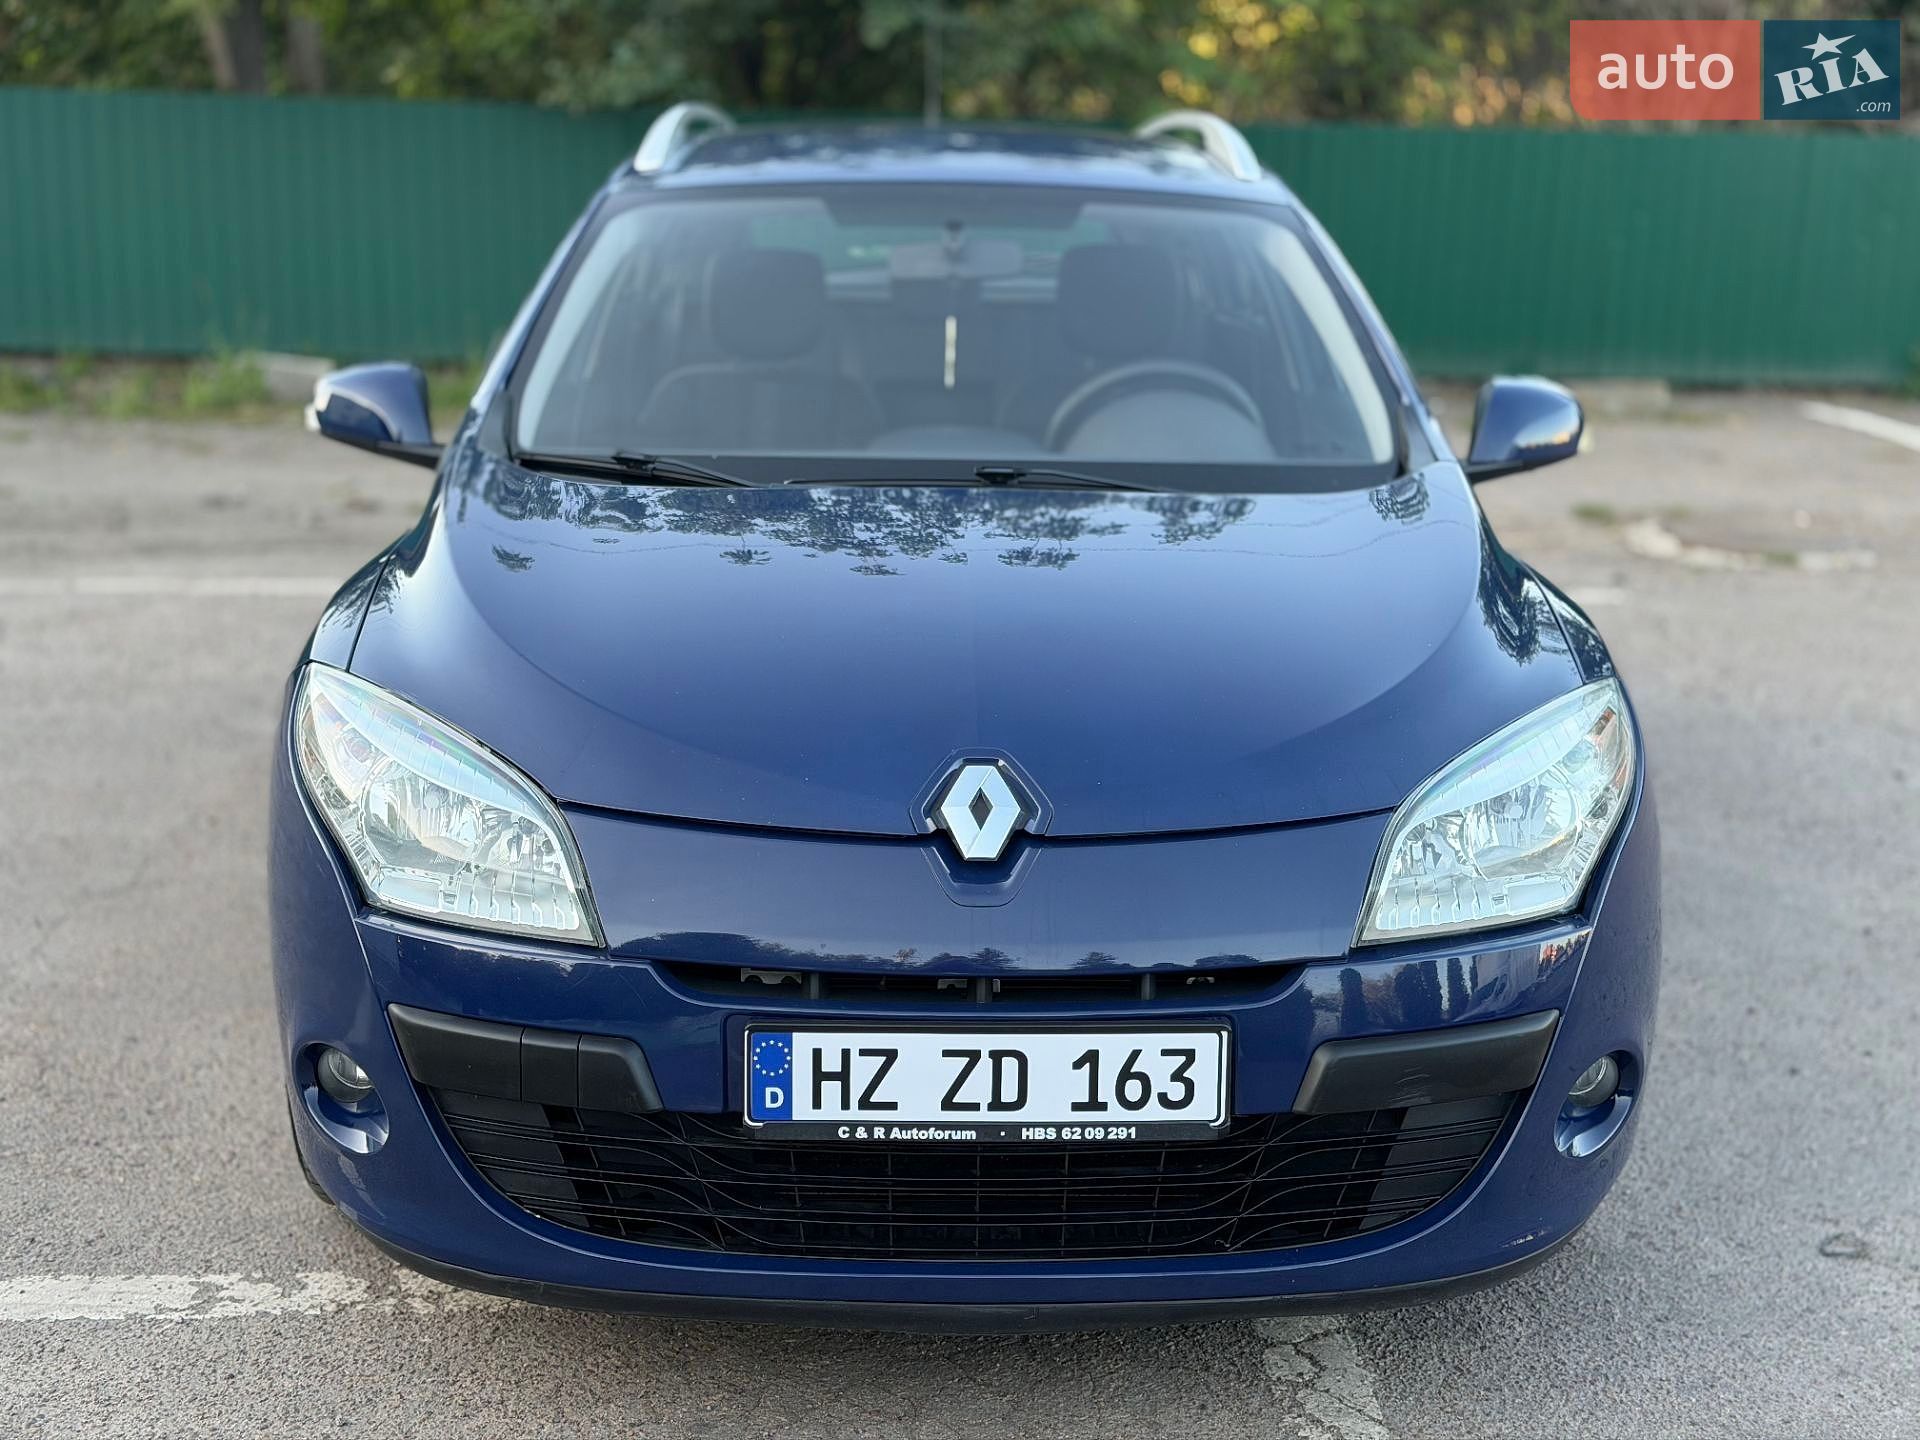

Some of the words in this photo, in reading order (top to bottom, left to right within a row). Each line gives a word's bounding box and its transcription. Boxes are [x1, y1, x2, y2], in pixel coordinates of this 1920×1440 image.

[812, 1048, 899, 1111] HZ
[940, 1049, 1029, 1112] ZD
[1071, 1049, 1197, 1112] 163
[765, 1087, 785, 1109] D
[837, 1126, 850, 1139] C
[855, 1126, 868, 1139] &
[873, 1127, 886, 1139] R
[889, 1127, 977, 1140] Autoforum
[1021, 1127, 1057, 1140] HBS
[1061, 1127, 1082, 1140] 62
[1084, 1127, 1105, 1140] 09
[1107, 1126, 1136, 1139] 291
